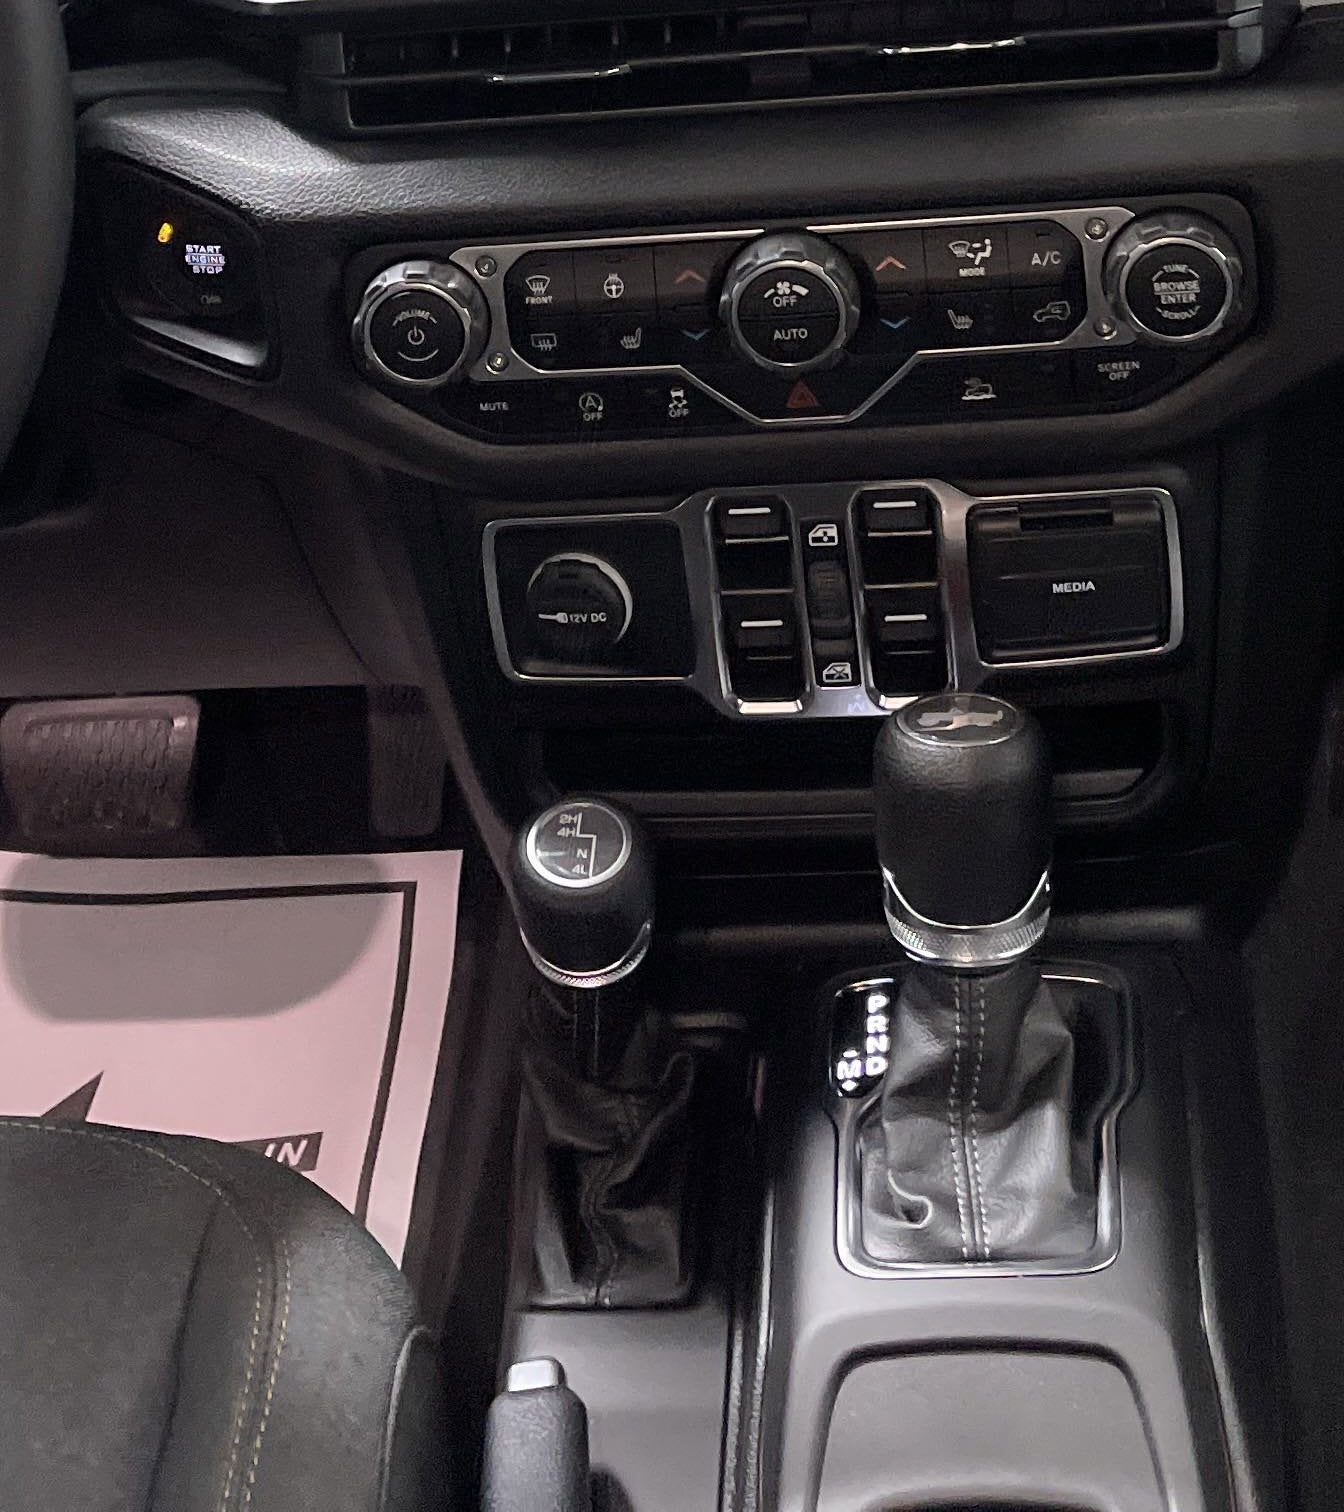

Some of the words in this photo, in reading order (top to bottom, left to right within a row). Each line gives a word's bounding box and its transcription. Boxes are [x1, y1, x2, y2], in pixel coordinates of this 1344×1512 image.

[185, 244, 222, 254] START
[185, 254, 225, 265] ENGINE
[1031, 251, 1061, 267] A/C
[192, 265, 224, 275] STOP
[959, 267, 985, 277] MODE
[1162, 263, 1189, 274] TUNE
[1153, 280, 1200, 292] BROWSE
[525, 294, 553, 305] FRONT
[772, 295, 798, 308] OFF
[1160, 292, 1197, 305] ENTER
[1160, 308, 1198, 320] SCROLL
[773, 328, 808, 341] AUTO
[1097, 360, 1141, 373] SCREEN
[1108, 371, 1130, 382] OFF
[479, 401, 510, 412] MUTE
[582, 411, 604, 422] OFF
[668, 409, 690, 419] OFF
[1052, 580, 1096, 594] MEDIA
[568, 611, 589, 624] 12V
[589, 610, 607, 624] DC
[559, 814, 577, 825] 2H
[556, 827, 576, 838] 4H
[576, 848, 588, 859] N
[571, 863, 588, 875] 4L
[866, 992, 890, 1013] P
[865, 1014, 890, 1033] R
[865, 1034, 891, 1055] N
[836, 1058, 863, 1080] M
[864, 1056, 889, 1077] D
